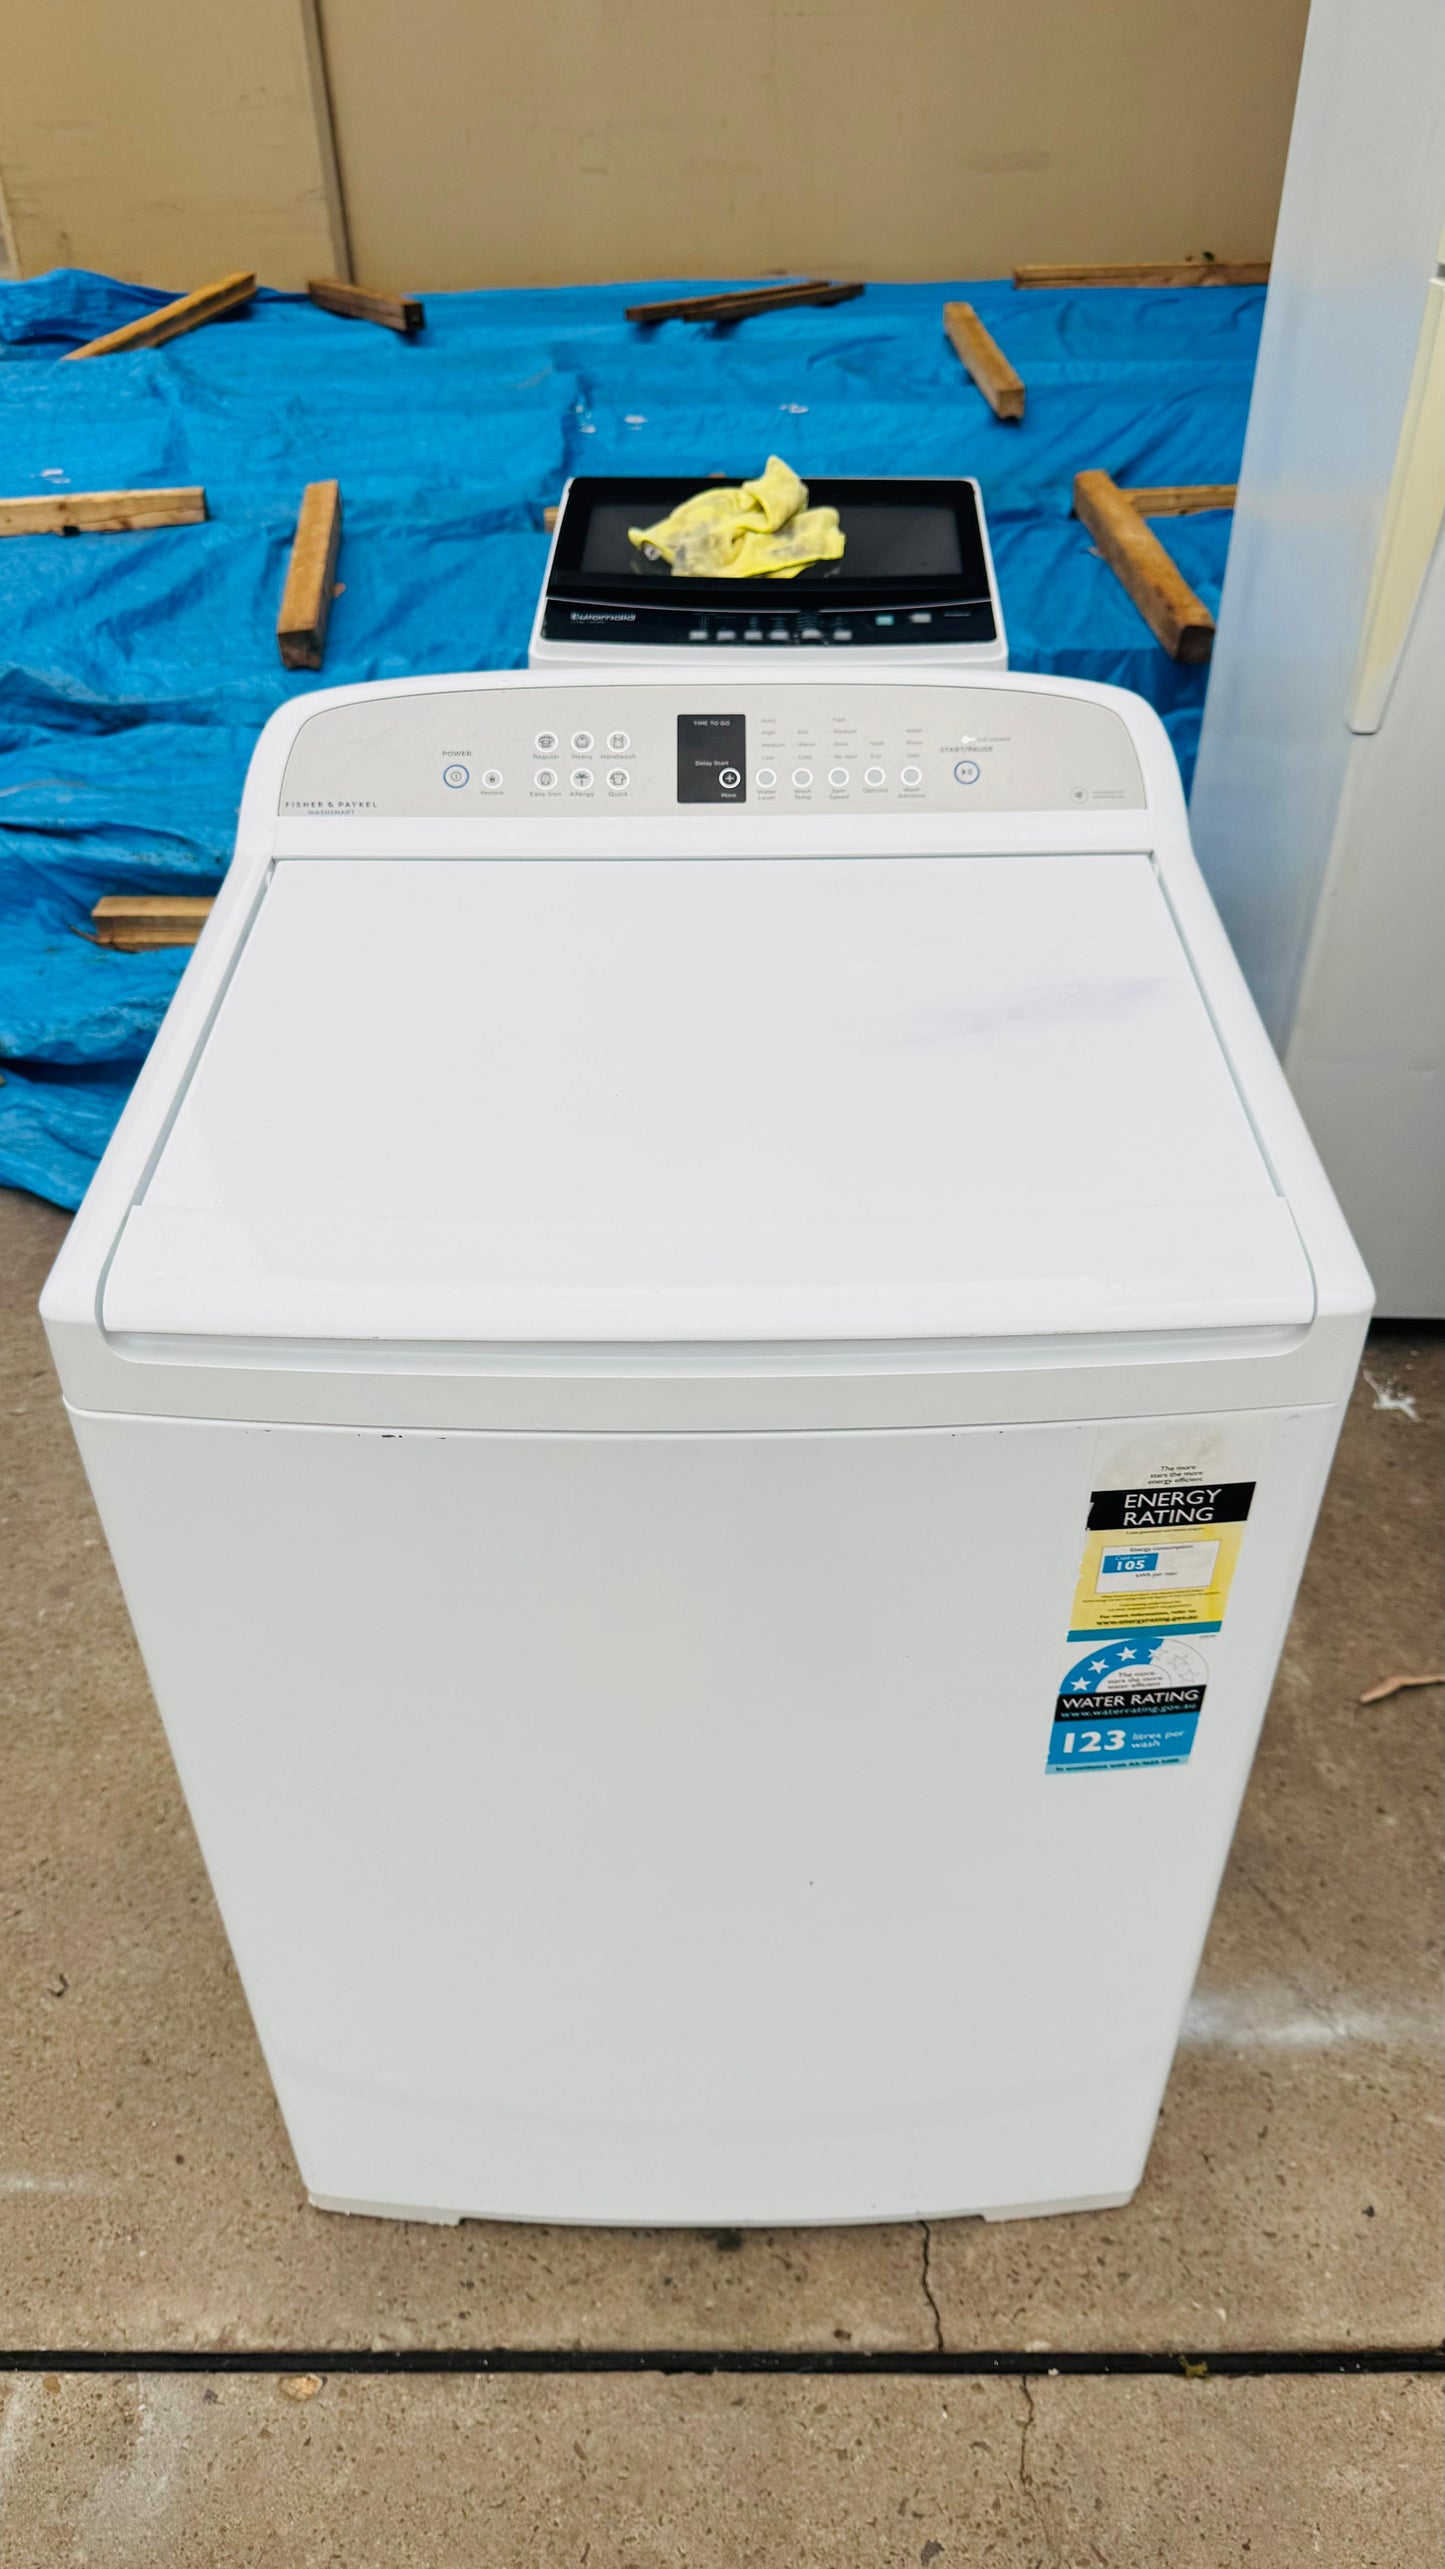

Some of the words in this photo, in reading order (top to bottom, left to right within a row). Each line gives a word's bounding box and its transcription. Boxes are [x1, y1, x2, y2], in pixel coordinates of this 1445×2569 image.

[1124, 1488, 1222, 1508] ENERGY
[1123, 1507, 1215, 1526] RATING
[1116, 1560, 1145, 1571] 105
[1096, 1615, 1198, 1625] www.energyrating.gov.au
[1063, 1695, 1125, 1709] WATER
[1131, 1689, 1199, 1705] RATING
[1061, 1703, 1197, 1718] www.waterrating.gov.au
[1063, 1730, 1126, 1753] 123
[1132, 1732, 1162, 1740] litres
[1165, 1730, 1184, 1739] per
[1131, 1740, 1160, 1748] wash
